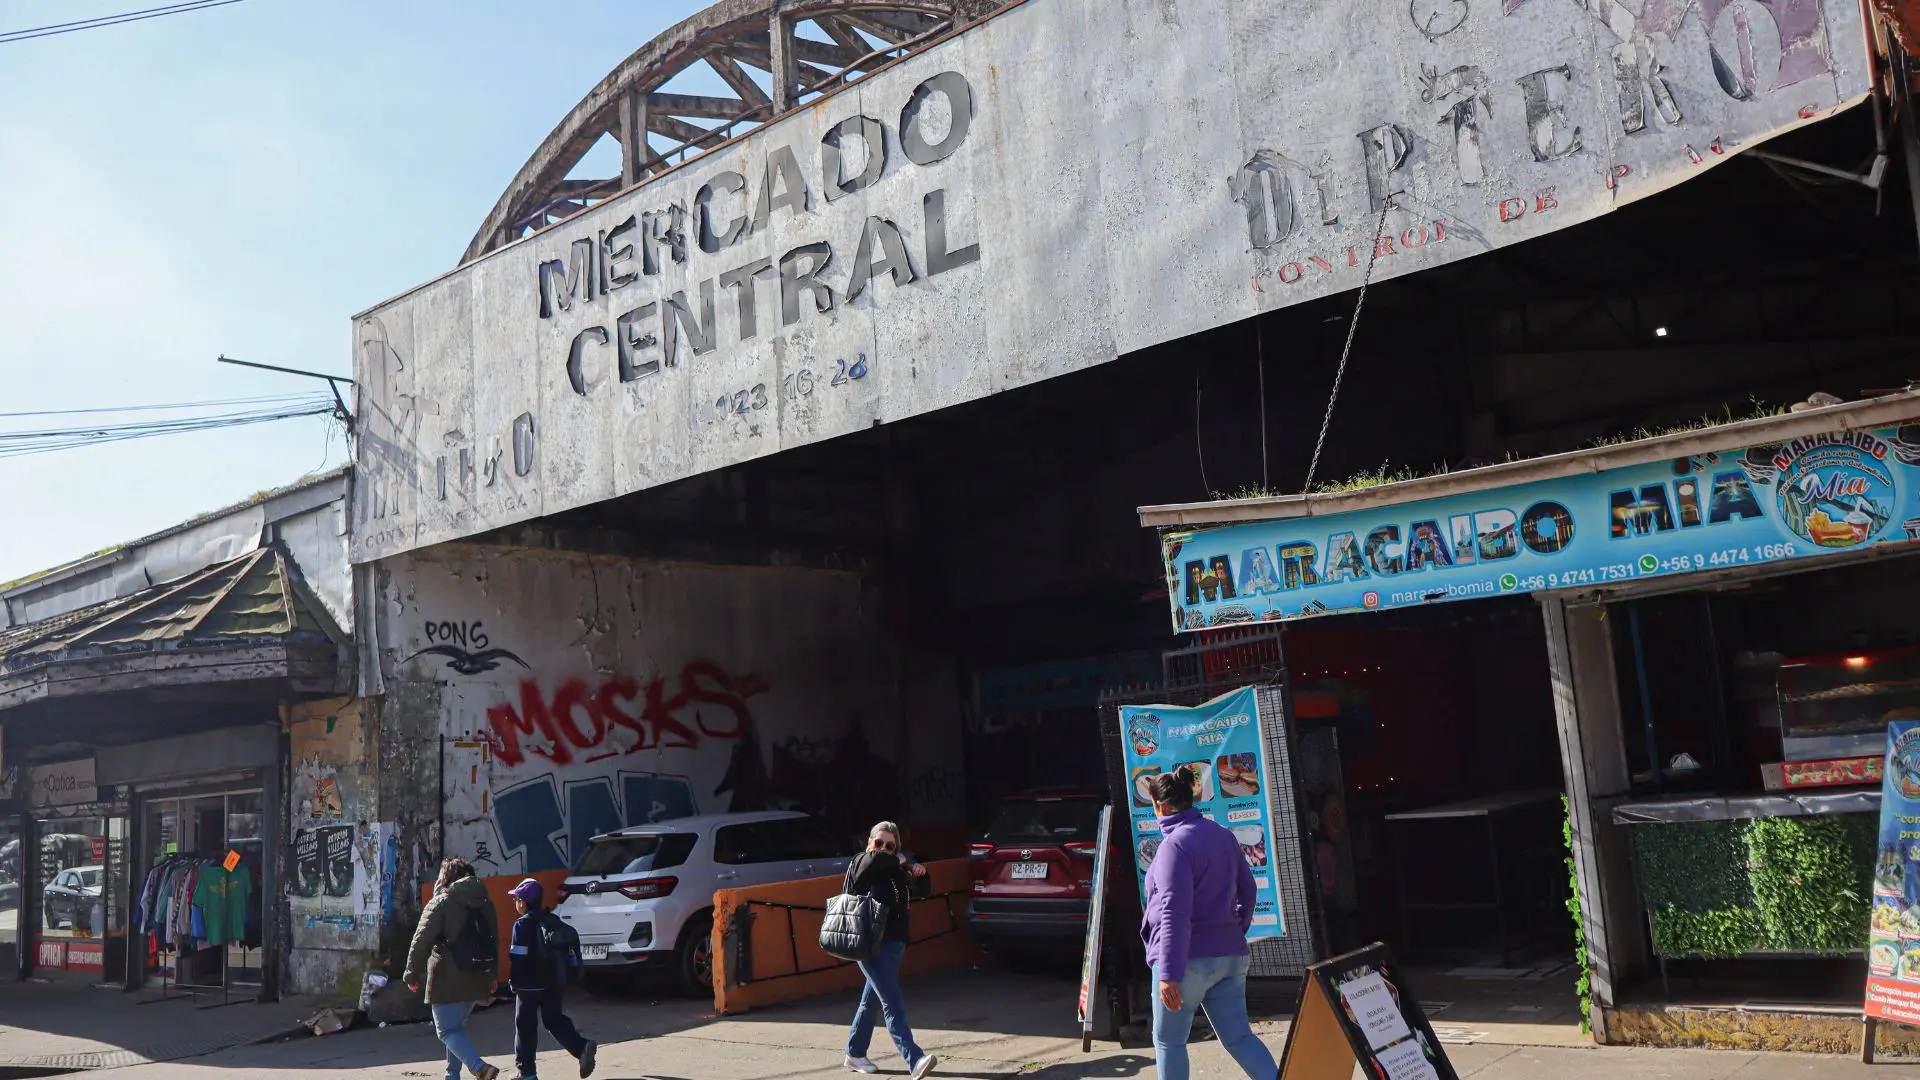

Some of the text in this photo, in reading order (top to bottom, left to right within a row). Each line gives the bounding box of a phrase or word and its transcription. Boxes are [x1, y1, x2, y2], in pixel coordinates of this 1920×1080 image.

[538, 70, 973, 319] MERCADO
[566, 187, 980, 395] CENTRAL
[1184, 499, 1576, 608] MARACAIBO
[1519, 574, 1546, 590] +56
[1548, 572, 1559, 586] 9
[1561, 569, 1596, 586] 4741
[1600, 563, 1636, 581] 7531
[1660, 554, 1690, 571] +56
[1694, 552, 1705, 567] 9
[1708, 547, 1750, 565] 4474
[1755, 541, 1796, 559] 1666
[425, 620, 490, 649] PONS
[1166, 713, 1251, 738] MARACAIBO
[39, 944, 61, 966] OPTICA
